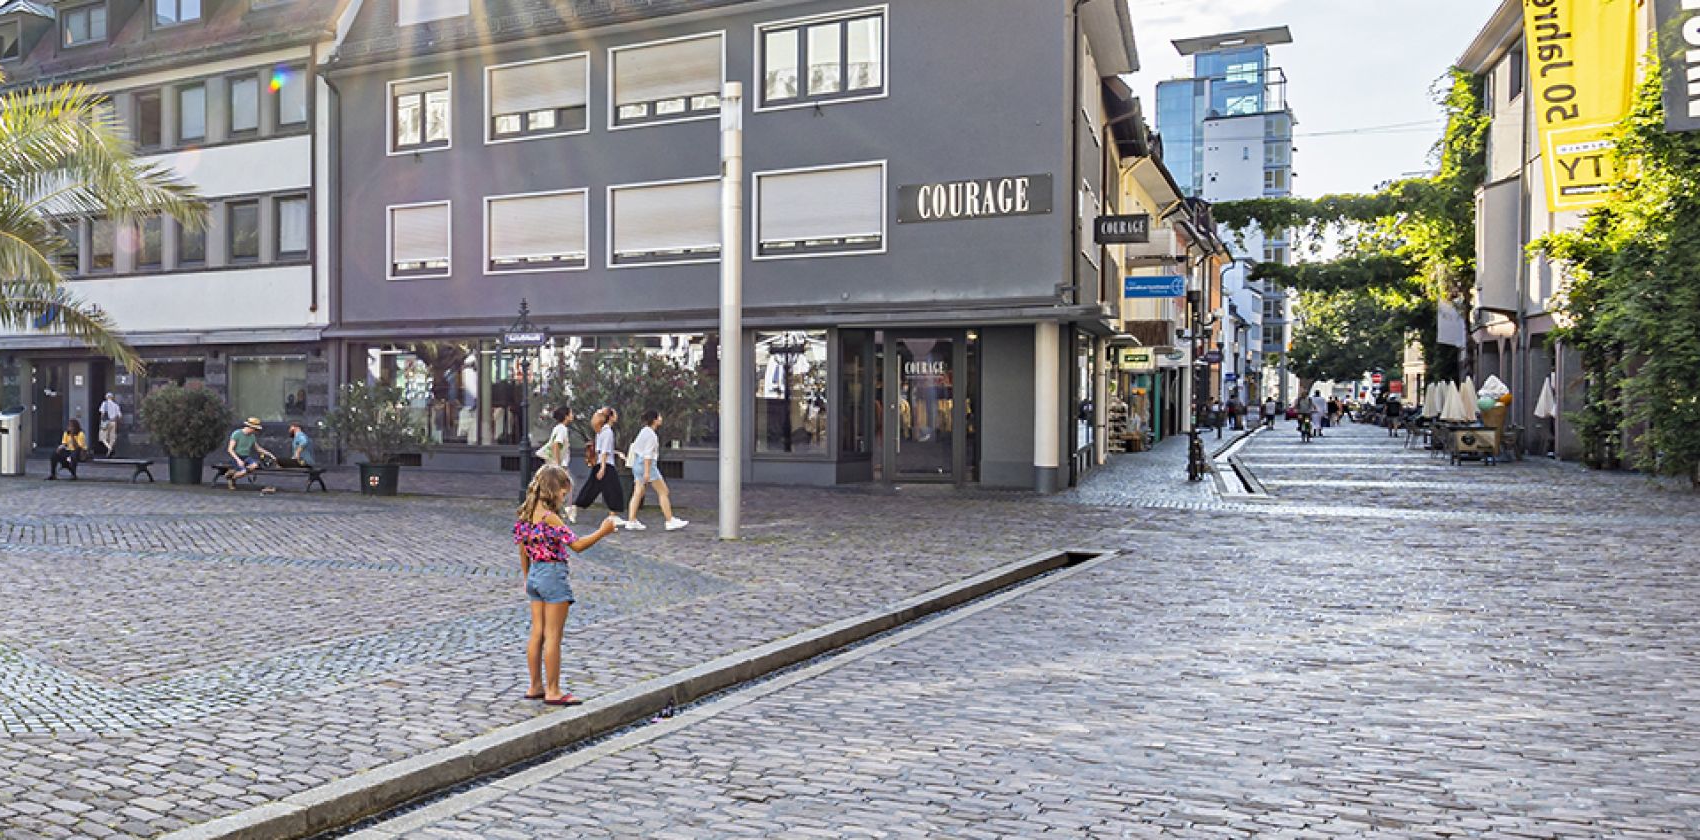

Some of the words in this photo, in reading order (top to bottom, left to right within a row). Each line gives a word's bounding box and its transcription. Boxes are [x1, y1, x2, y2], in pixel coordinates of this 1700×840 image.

[918, 177, 1030, 218] COURAGE
[1101, 220, 1145, 235] COURAGE
[904, 361, 945, 374] COURAGE
